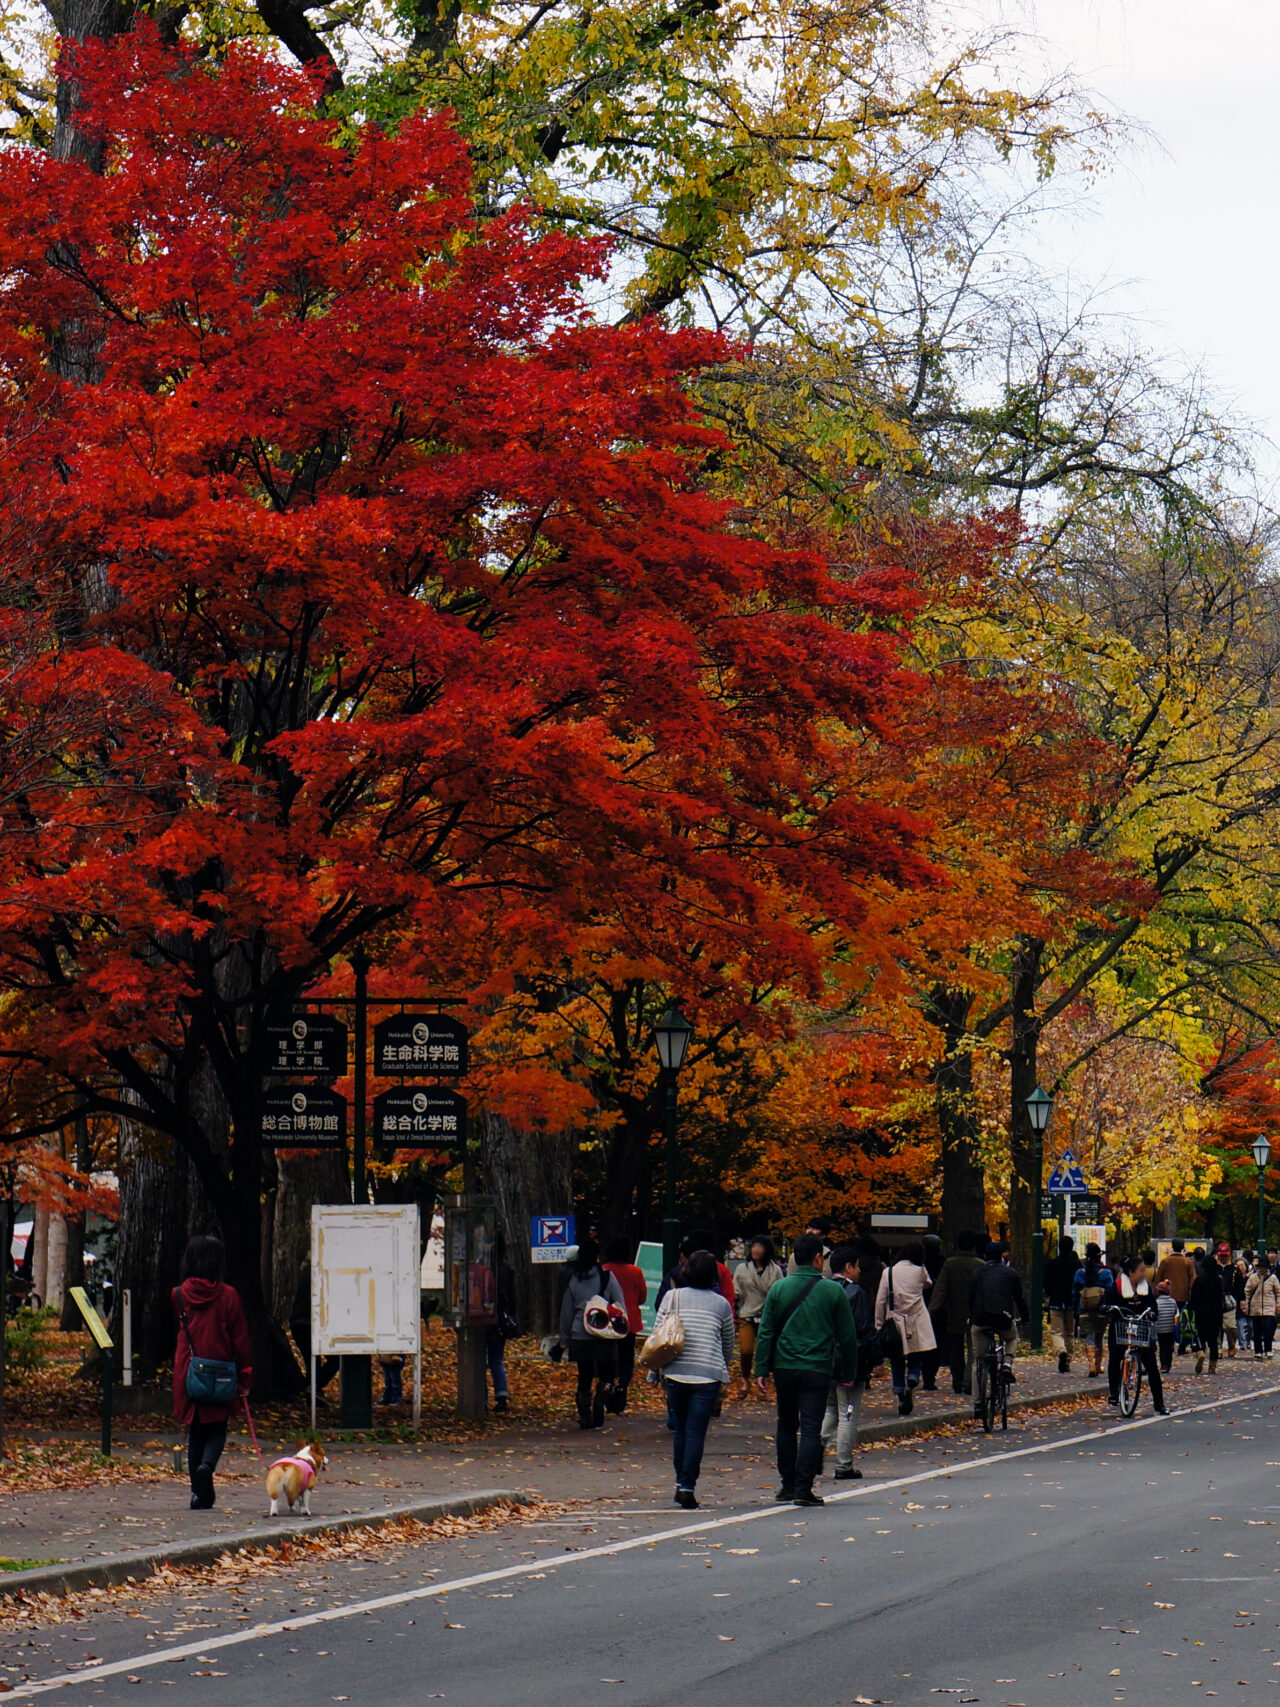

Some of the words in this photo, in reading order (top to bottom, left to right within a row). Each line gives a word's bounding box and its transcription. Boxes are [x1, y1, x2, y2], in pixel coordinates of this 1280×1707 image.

[382, 1045, 459, 1061] 生命科学院
[405, 1062, 422, 1070] School
[429, 1062, 439, 1070] Life
[262, 1115, 338, 1130] 総合博物館
[382, 1115, 457, 1131] 総合化学院
